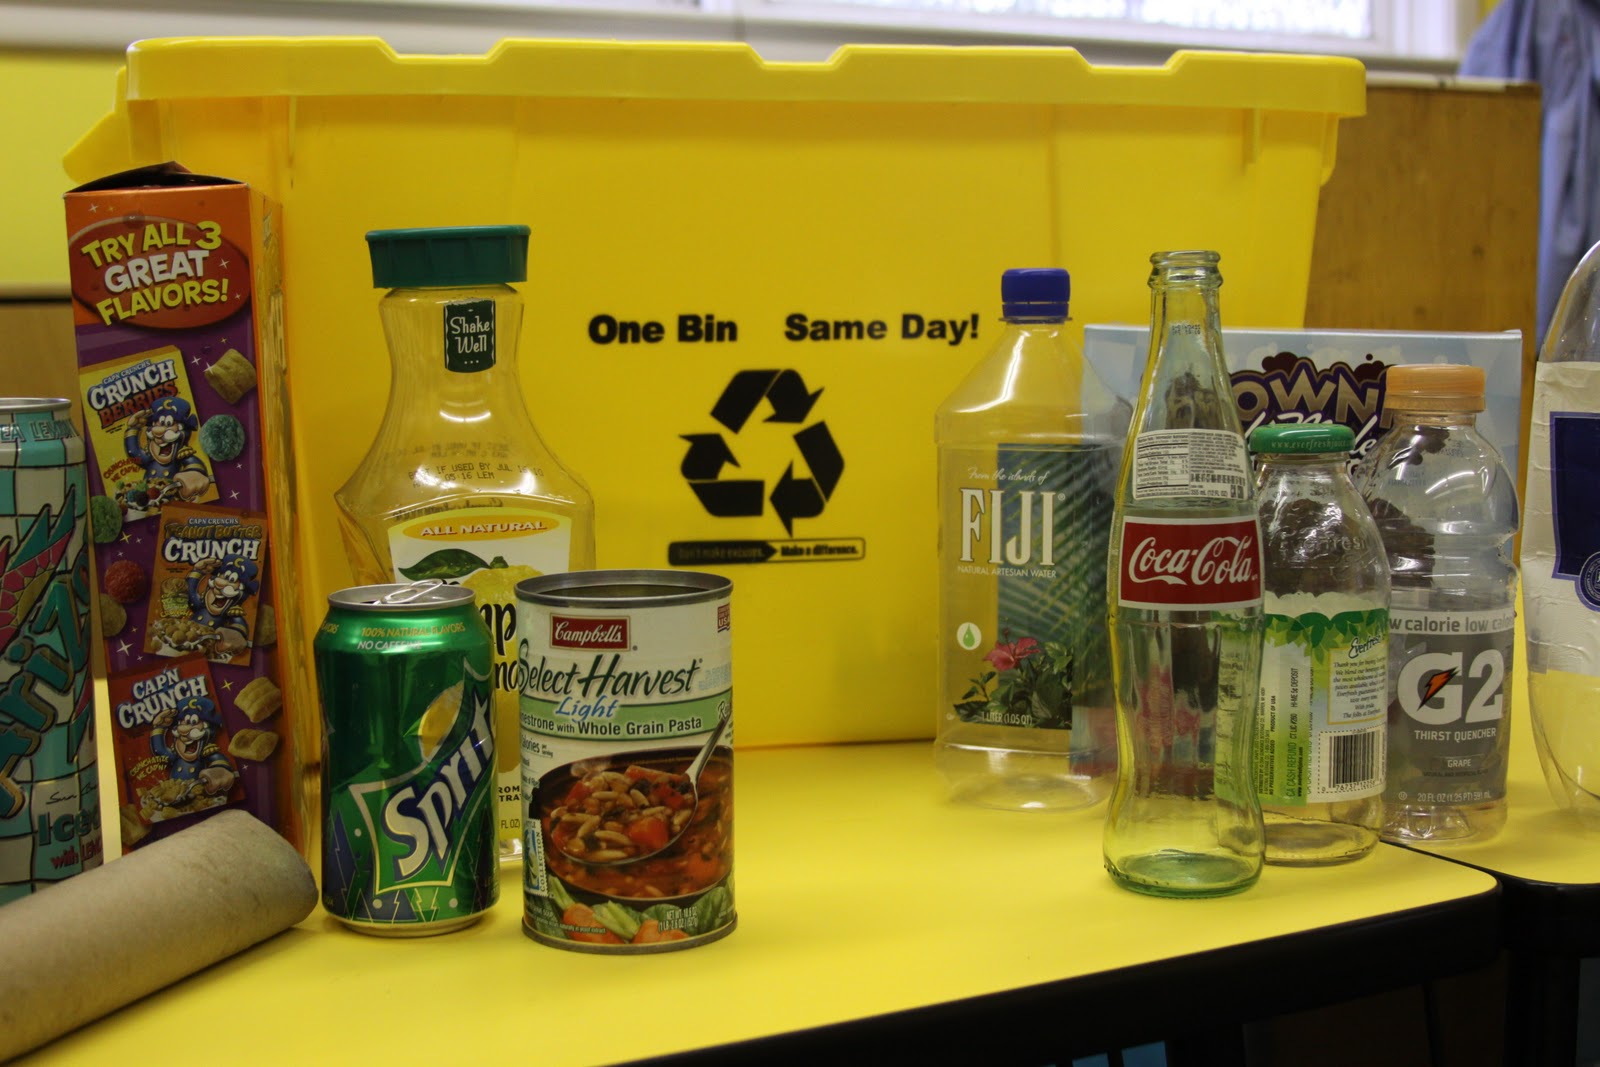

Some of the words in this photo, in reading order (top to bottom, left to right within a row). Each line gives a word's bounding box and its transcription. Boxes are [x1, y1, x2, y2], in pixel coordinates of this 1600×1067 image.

[82, 232, 135, 269] TRY
[142, 222, 191, 251] ALL
[195, 220, 223, 250] 3
[104, 249, 209, 293] GREAT
[96, 278, 229, 326] FLAVORS!
[450, 315, 490, 335] Shake
[589, 314, 664, 344] One
[677, 314, 737, 342] Bin
[785, 313, 887, 341] Same
[901, 313, 979, 346] Day!
[455, 334, 487, 354] Well
[89, 360, 177, 410] CRUNCH
[99, 380, 178, 428] BERRIES
[451, 462, 475, 472] USED
[478, 462, 491, 471] BY
[477, 471, 496, 480] LEM
[1008, 468, 1036, 482] islands
[1037, 471, 1051, 485] of
[164, 522, 214, 539] PEANUT
[214, 525, 262, 539] BUTTER
[421, 525, 459, 537] ALL
[460, 521, 548, 535] NATURAL
[960, 488, 1056, 566] FIJI
[164, 538, 261, 564] CRUNCH
[1129, 536, 1253, 586] Coca-Cola
[958, 565, 990, 576] NATURAL
[992, 567, 1029, 577] ARTESIAN
[1031, 568, 1057, 579] WATER
[361, 627, 386, 638] 100%
[386, 626, 430, 638] NATURAL
[431, 622, 466, 635] FLAVORS
[555, 621, 623, 646] Campbell's
[1404, 616, 1460, 633] calorie
[1465, 616, 1489, 633] low
[357, 640, 374, 650] NO
[518, 638, 580, 696] Select
[578, 654, 701, 698] Harvest
[1290, 668, 1299, 687] DEPOSIT
[1397, 649, 1505, 725] G2
[118, 675, 208, 729] CRUNCH
[556, 696, 619, 723] Light
[557, 723, 575, 734] with
[577, 721, 621, 735] Whole
[626, 721, 664, 735] Grain
[668, 716, 702, 733] Pasta
[1414, 730, 1452, 741] THIRST
[1454, 727, 1497, 743] QUENCHER
[1287, 742, 1297, 768] REFUND
[1447, 758, 1472, 768] GRAPE
[1286, 769, 1297, 787] CASH
